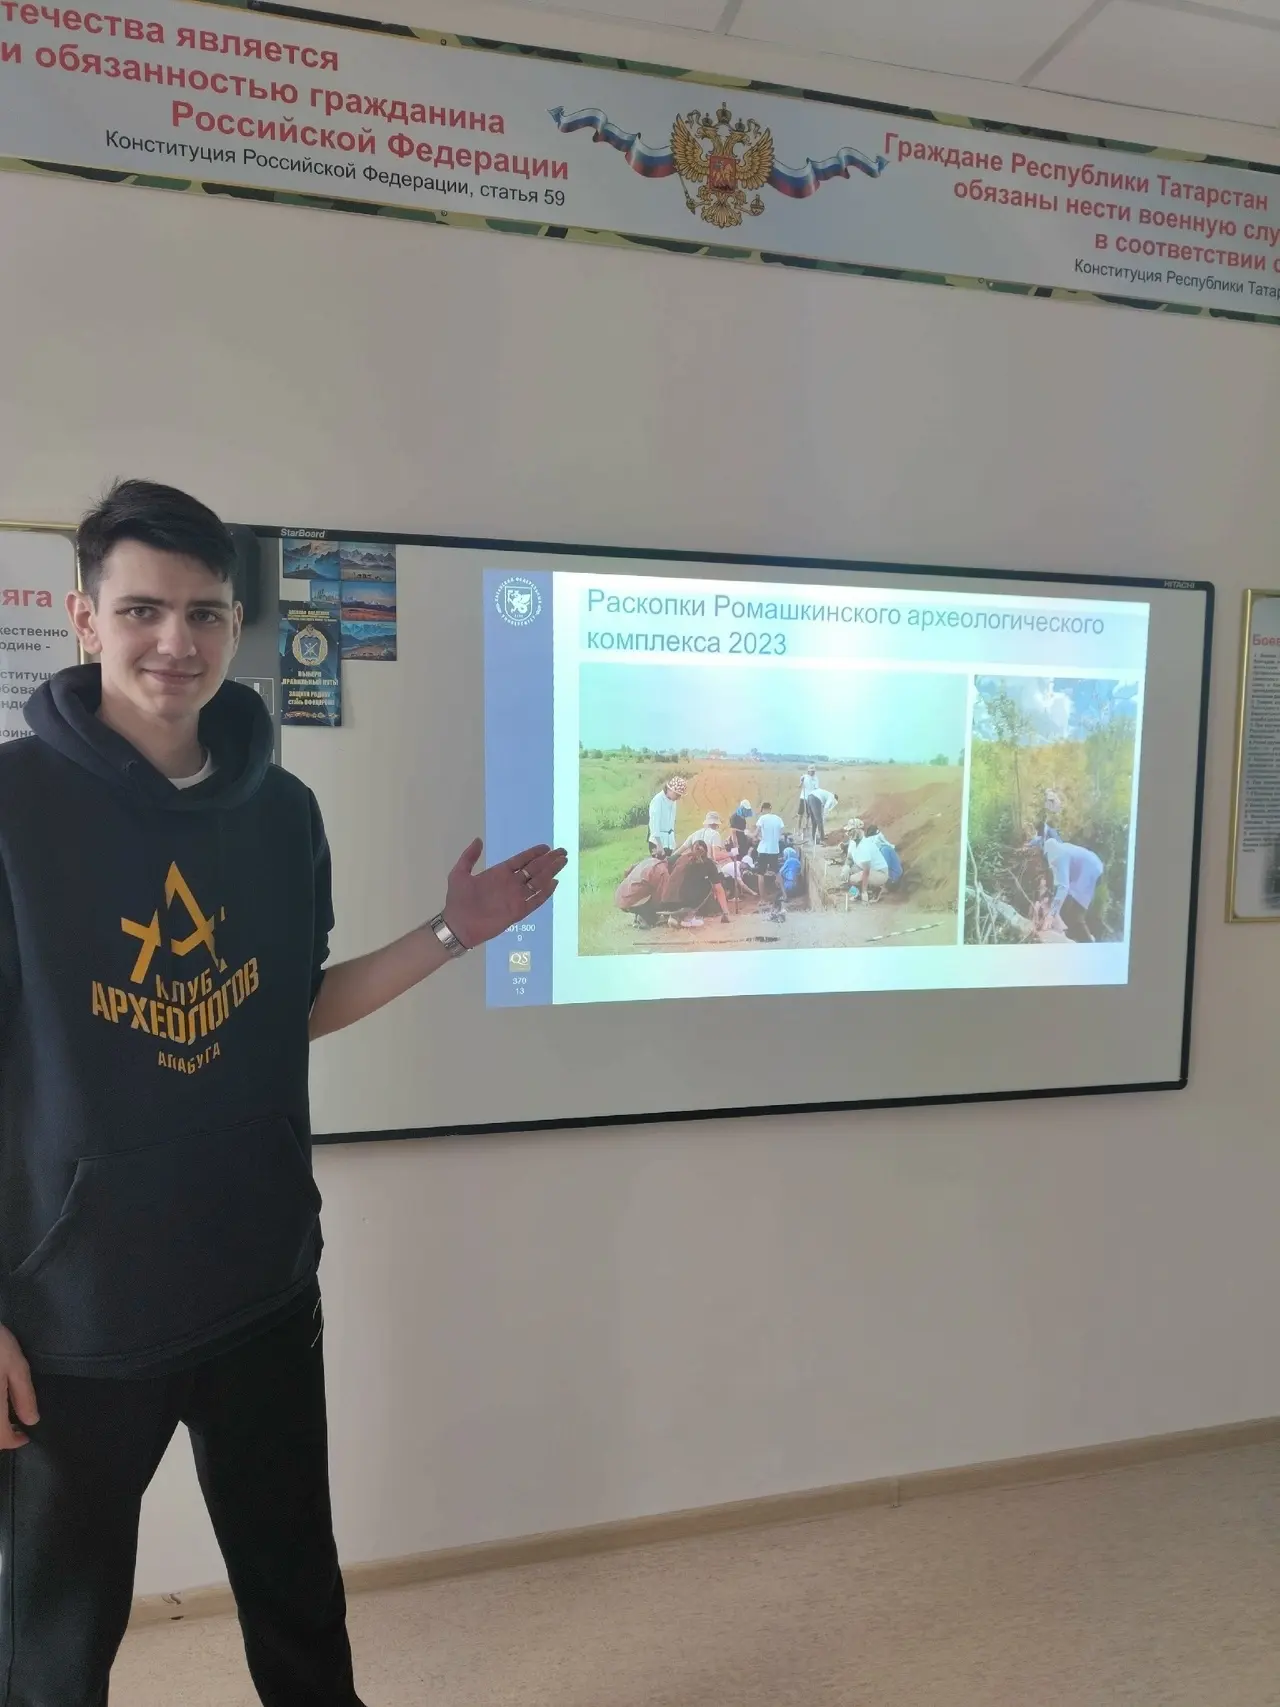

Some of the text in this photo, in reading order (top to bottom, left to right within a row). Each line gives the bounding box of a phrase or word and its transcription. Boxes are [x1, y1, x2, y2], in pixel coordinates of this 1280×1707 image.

[176, 27, 339, 71] является
[1, 41, 505, 135] и обязанностью гражданина
[171, 100, 568, 180] Российской Федерации
[105, 130, 565, 206] Конституция Российской Федерации, статья 59
[884, 132, 1268, 211] Граждане Республики Татарстан
[953, 180, 1058, 212] обязаны
[1065, 198, 1131, 222] нести
[1139, 208, 1237, 239] военную
[1095, 233, 1108, 250] в
[1115, 236, 1266, 272] соответствии
[1074, 258, 1162, 283] Конституция
[1166, 270, 1244, 293] Республики
[280, 528, 326, 539] StarBoard
[0, 589, 53, 608] яга
[1163, 580, 1196, 589] HITACHI
[587, 588, 1105, 635] Раскопки Ромашкинского археологического
[587, 631, 787, 655] комплекса 2023
[510, 952, 529, 966] QS
[92, 957, 259, 1046] АРХЕОЛОГОВ
[155, 967, 213, 1006] КЛУБ
